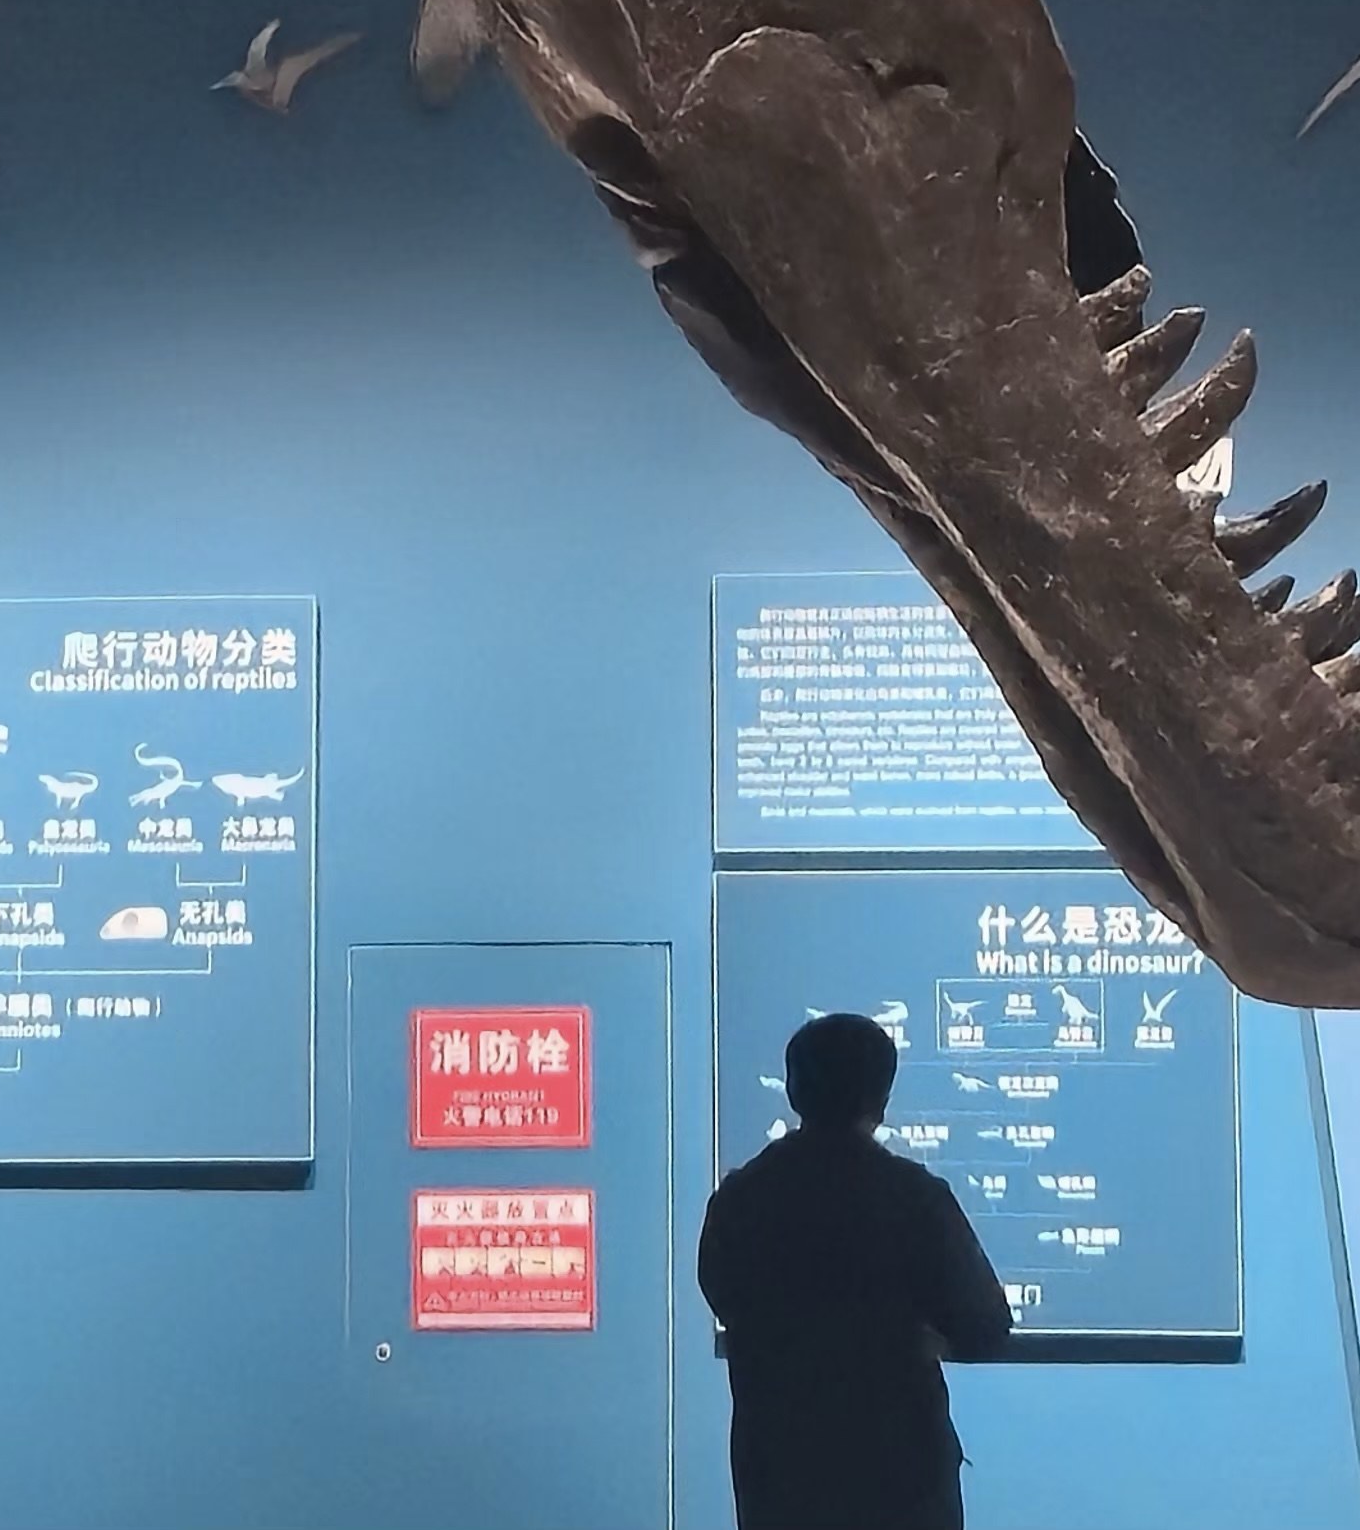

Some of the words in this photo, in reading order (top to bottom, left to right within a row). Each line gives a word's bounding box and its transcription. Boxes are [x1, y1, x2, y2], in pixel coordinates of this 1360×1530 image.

[63, 628, 296, 669] 爬行动物分类
[30, 669, 178, 692] Classification
[183, 668, 209, 691] of
[212, 669, 297, 694] reptiles
[977, 905, 1186, 946] 什么是恐龙
[977, 950, 1039, 975] What
[1043, 951, 1065, 974] is
[1067, 954, 1082, 974] a
[1086, 948, 1205, 975] dinosaur?
[430, 1028, 570, 1075] 消防栓
[431, 1199, 574, 1220] 灭火器放置点
